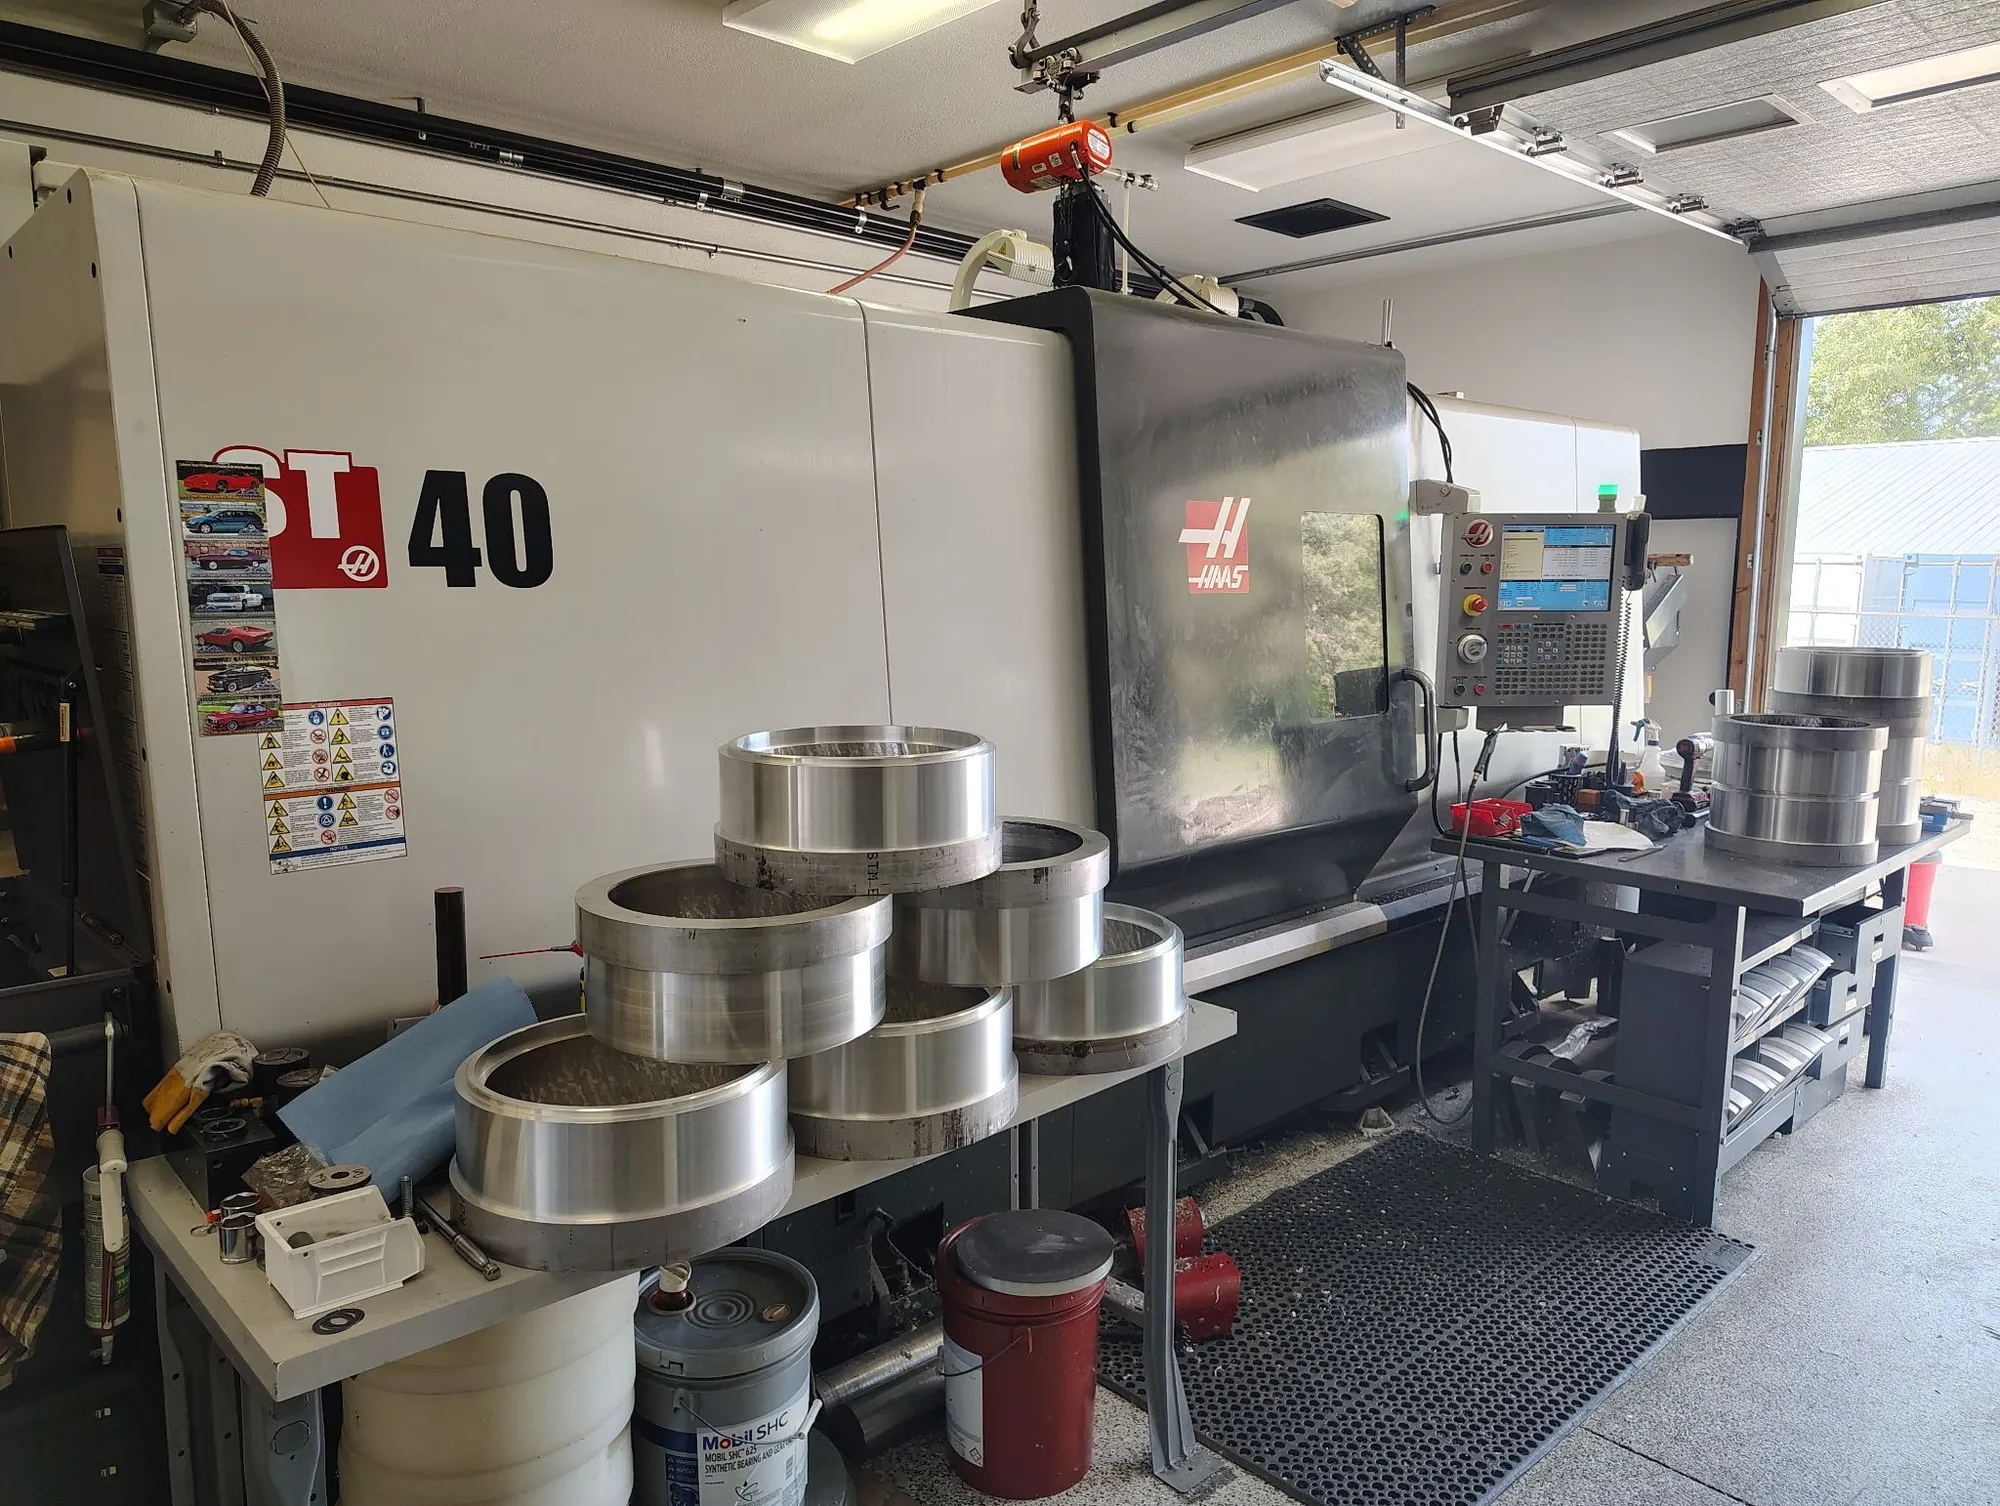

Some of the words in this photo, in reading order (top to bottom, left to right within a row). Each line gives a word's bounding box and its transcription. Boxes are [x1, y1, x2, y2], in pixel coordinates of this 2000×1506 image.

[408, 470, 554, 588] 40
[1188, 564, 1249, 589] HAAS
[702, 1429, 753, 1451] Mobil
[756, 1411, 789, 1440] SHC
[704, 1452, 727, 1463] MOBIL
[745, 1445, 758, 1457] 625
[704, 1461, 737, 1474] SYNTHETIC
[737, 1455, 761, 1470] BEARING
[762, 1449, 773, 1461] AND
